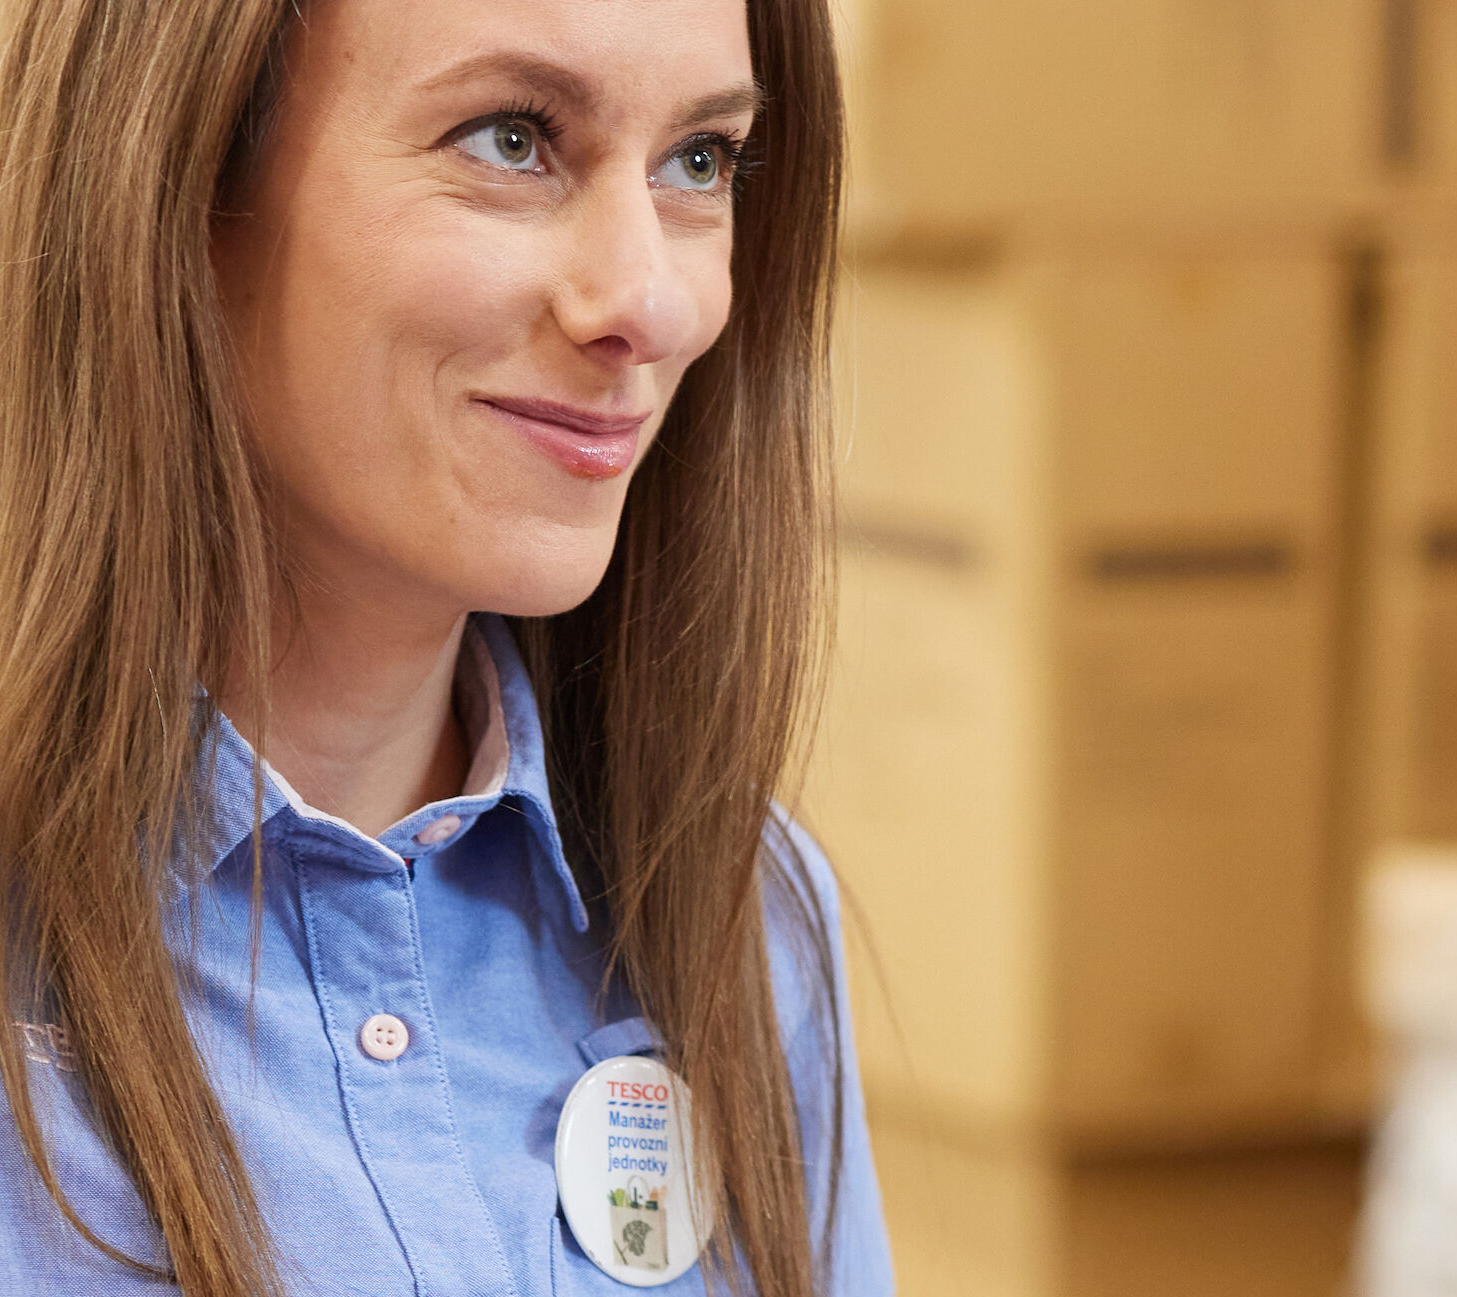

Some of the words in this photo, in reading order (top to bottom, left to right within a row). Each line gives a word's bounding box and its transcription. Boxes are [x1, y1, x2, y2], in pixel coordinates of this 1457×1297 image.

[606, 1080, 669, 1102] TESCO
[608, 1110, 668, 1131] Manažer
[607, 1152, 668, 1177] jednotky
